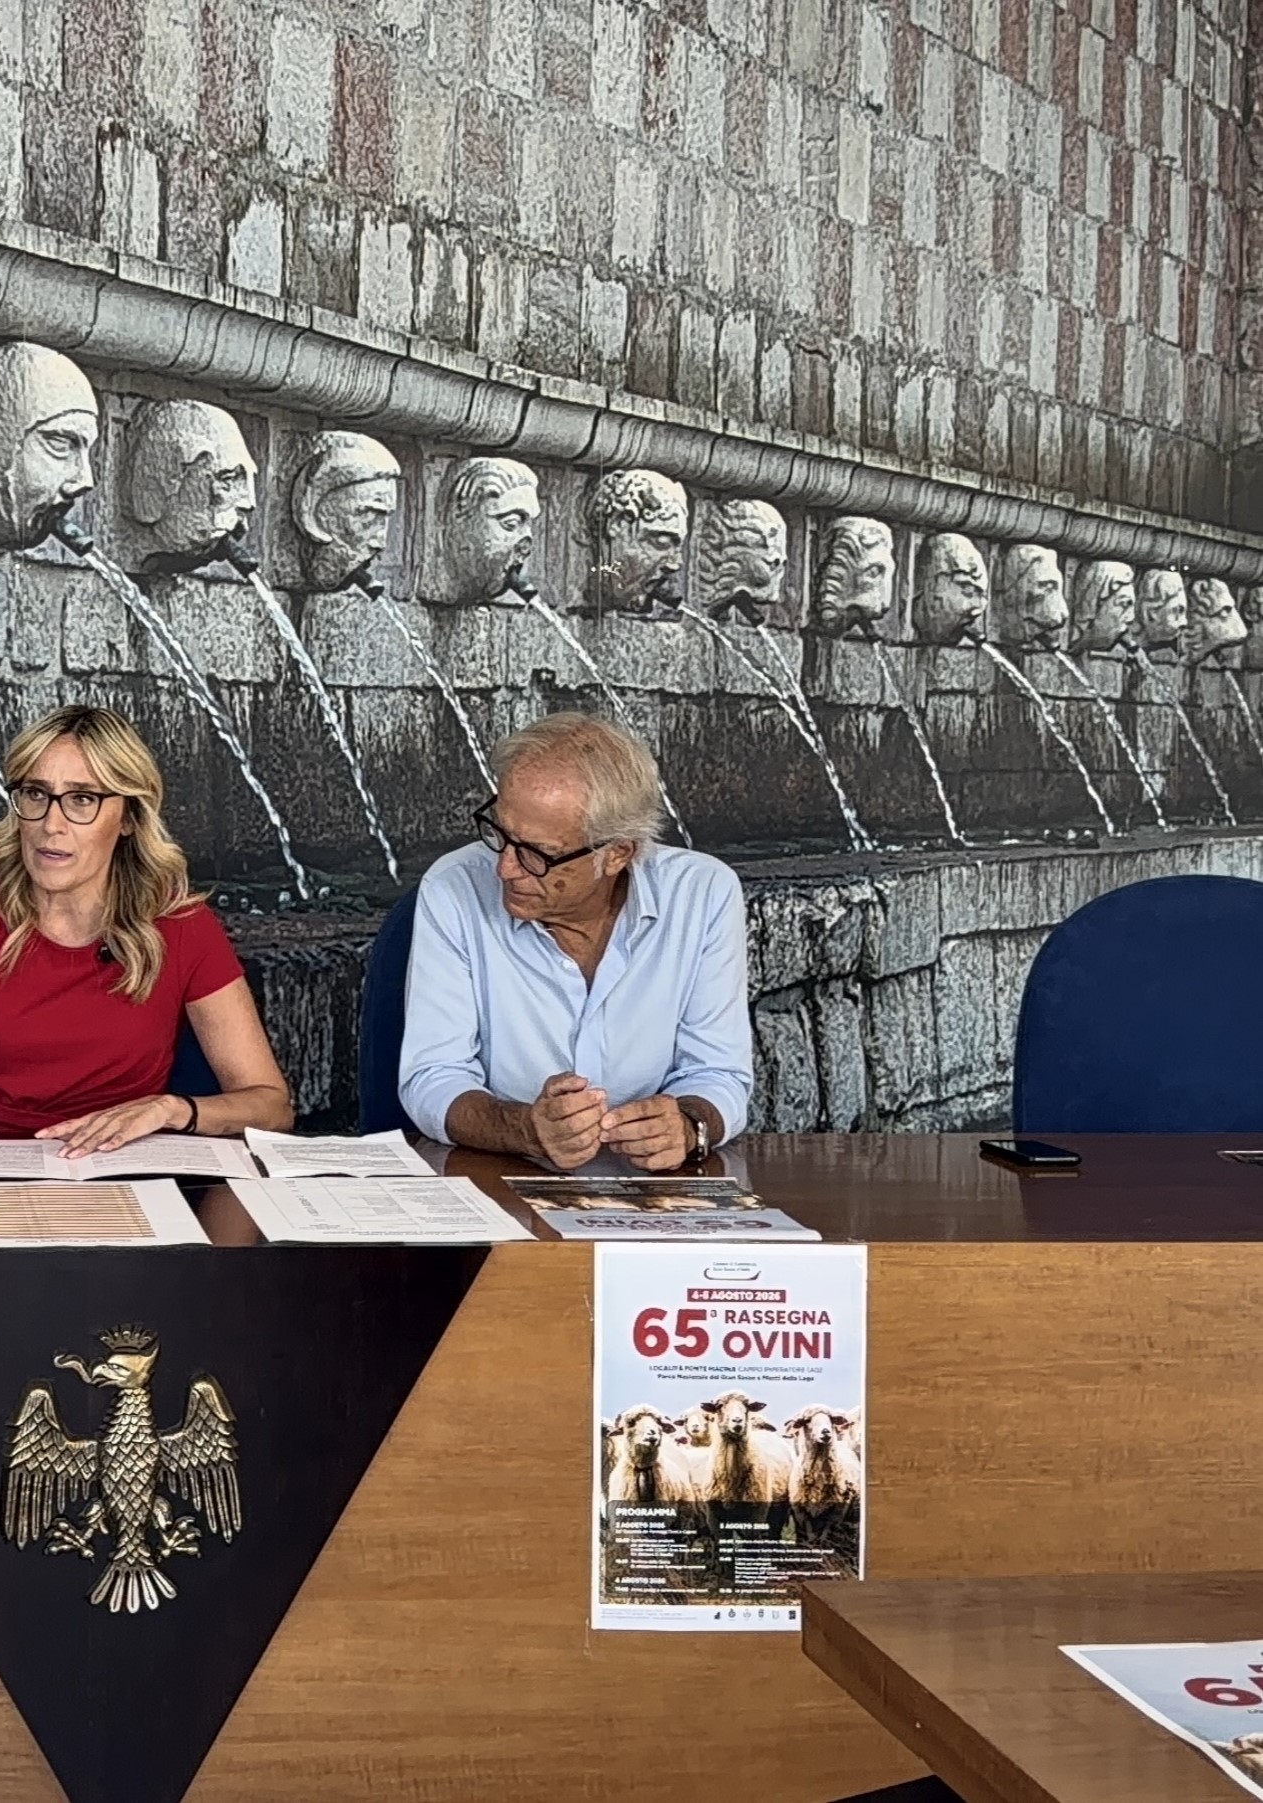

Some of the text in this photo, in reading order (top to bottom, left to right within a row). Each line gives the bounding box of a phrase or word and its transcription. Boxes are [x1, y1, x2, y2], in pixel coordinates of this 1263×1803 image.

[710, 1291, 754, 1300] AGOSTO
[755, 1291, 781, 1301] 2026
[724, 1309, 831, 1325] RASSEGNA
[722, 1330, 831, 1359] OVINI
[615, 1507, 677, 1517] PROGRAMMA
[1184, 1677, 1263, 1706] 6
